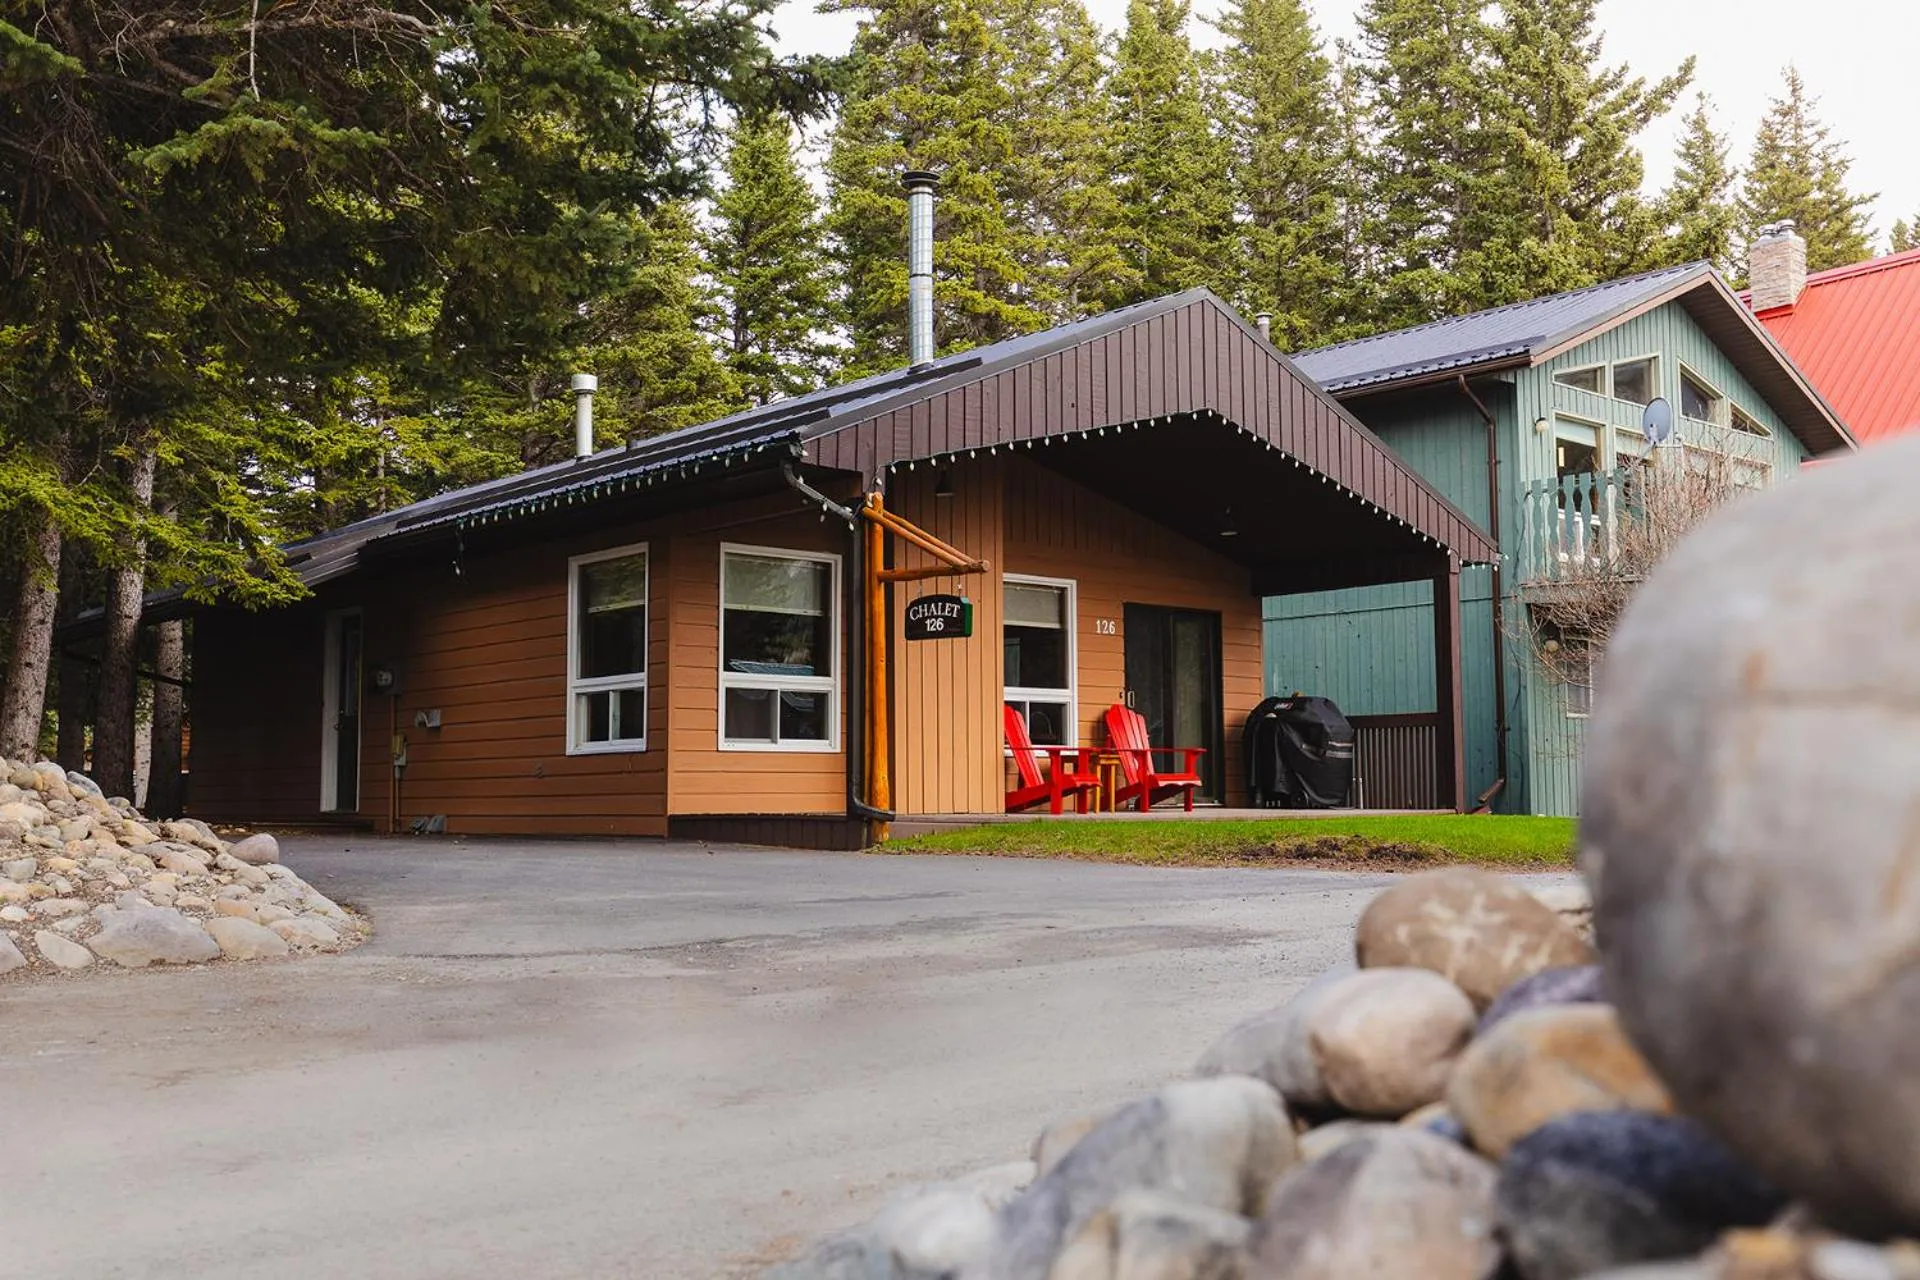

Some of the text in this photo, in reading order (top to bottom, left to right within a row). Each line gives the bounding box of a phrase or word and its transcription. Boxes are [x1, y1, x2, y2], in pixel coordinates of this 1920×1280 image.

[909, 602, 961, 620] CHALET
[925, 617, 944, 632] 126
[1096, 619, 1116, 635] 126
